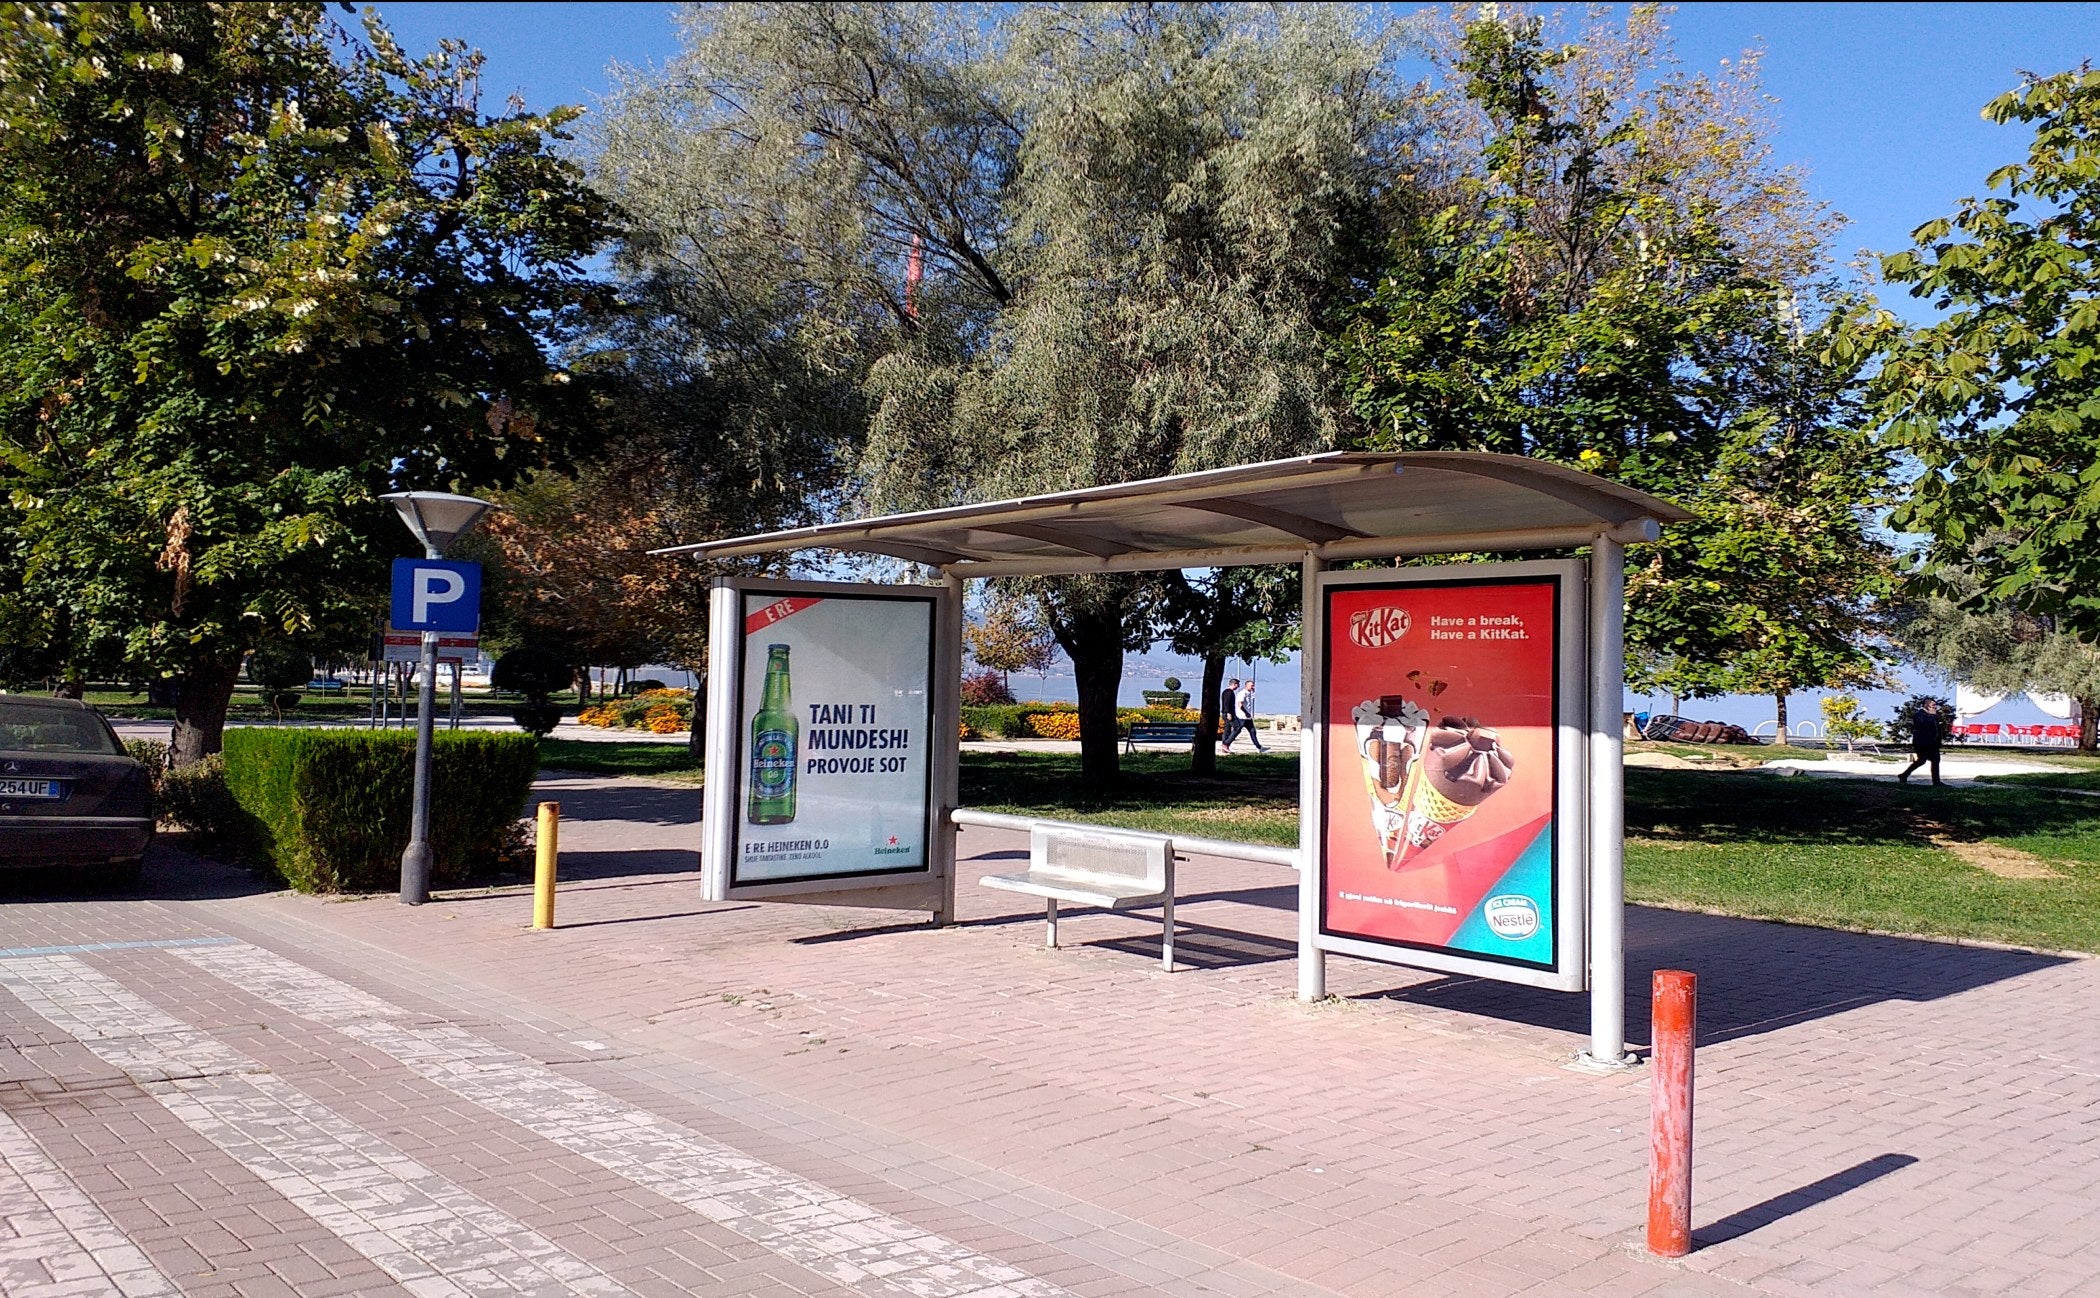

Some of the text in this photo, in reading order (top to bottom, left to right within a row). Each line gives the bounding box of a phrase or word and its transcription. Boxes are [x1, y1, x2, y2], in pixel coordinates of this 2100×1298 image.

[412, 568, 465, 623] P
[764, 599, 795, 623] E RE
[1357, 608, 1408, 647] KitKat
[1430, 615, 1524, 627] Have a break,
[1430, 628, 1530, 640] Have a KitKat.
[809, 704, 876, 724] TANI TI
[808, 729, 909, 750] MUNDESH!
[807, 756, 907, 774] PROVOJE SOT
[745, 839, 829, 854] E RE HEINEKEN 0.0
[874, 846, 911, 855] Heineken
